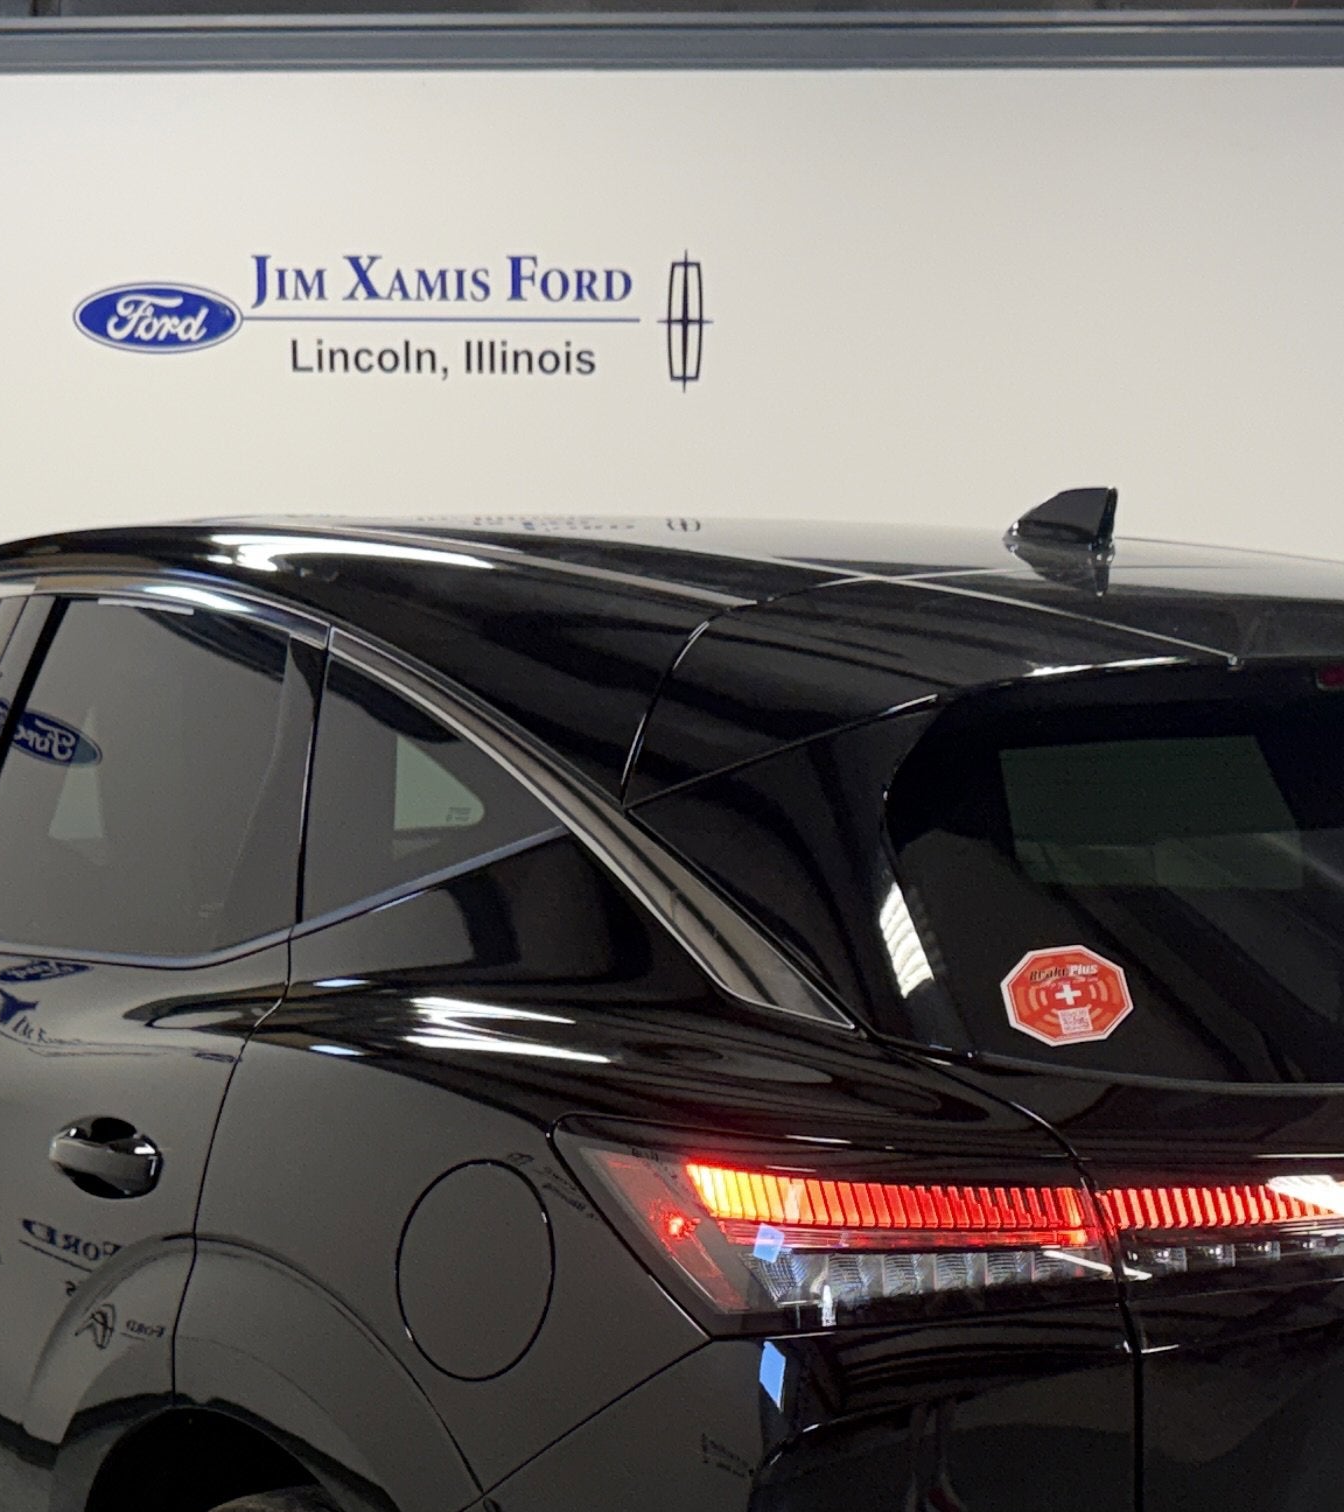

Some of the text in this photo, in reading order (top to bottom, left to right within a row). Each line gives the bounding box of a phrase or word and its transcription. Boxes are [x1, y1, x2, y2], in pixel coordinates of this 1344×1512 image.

[105, 293, 208, 343] Ford
[291, 339, 596, 380] Lincoln, Illinois
